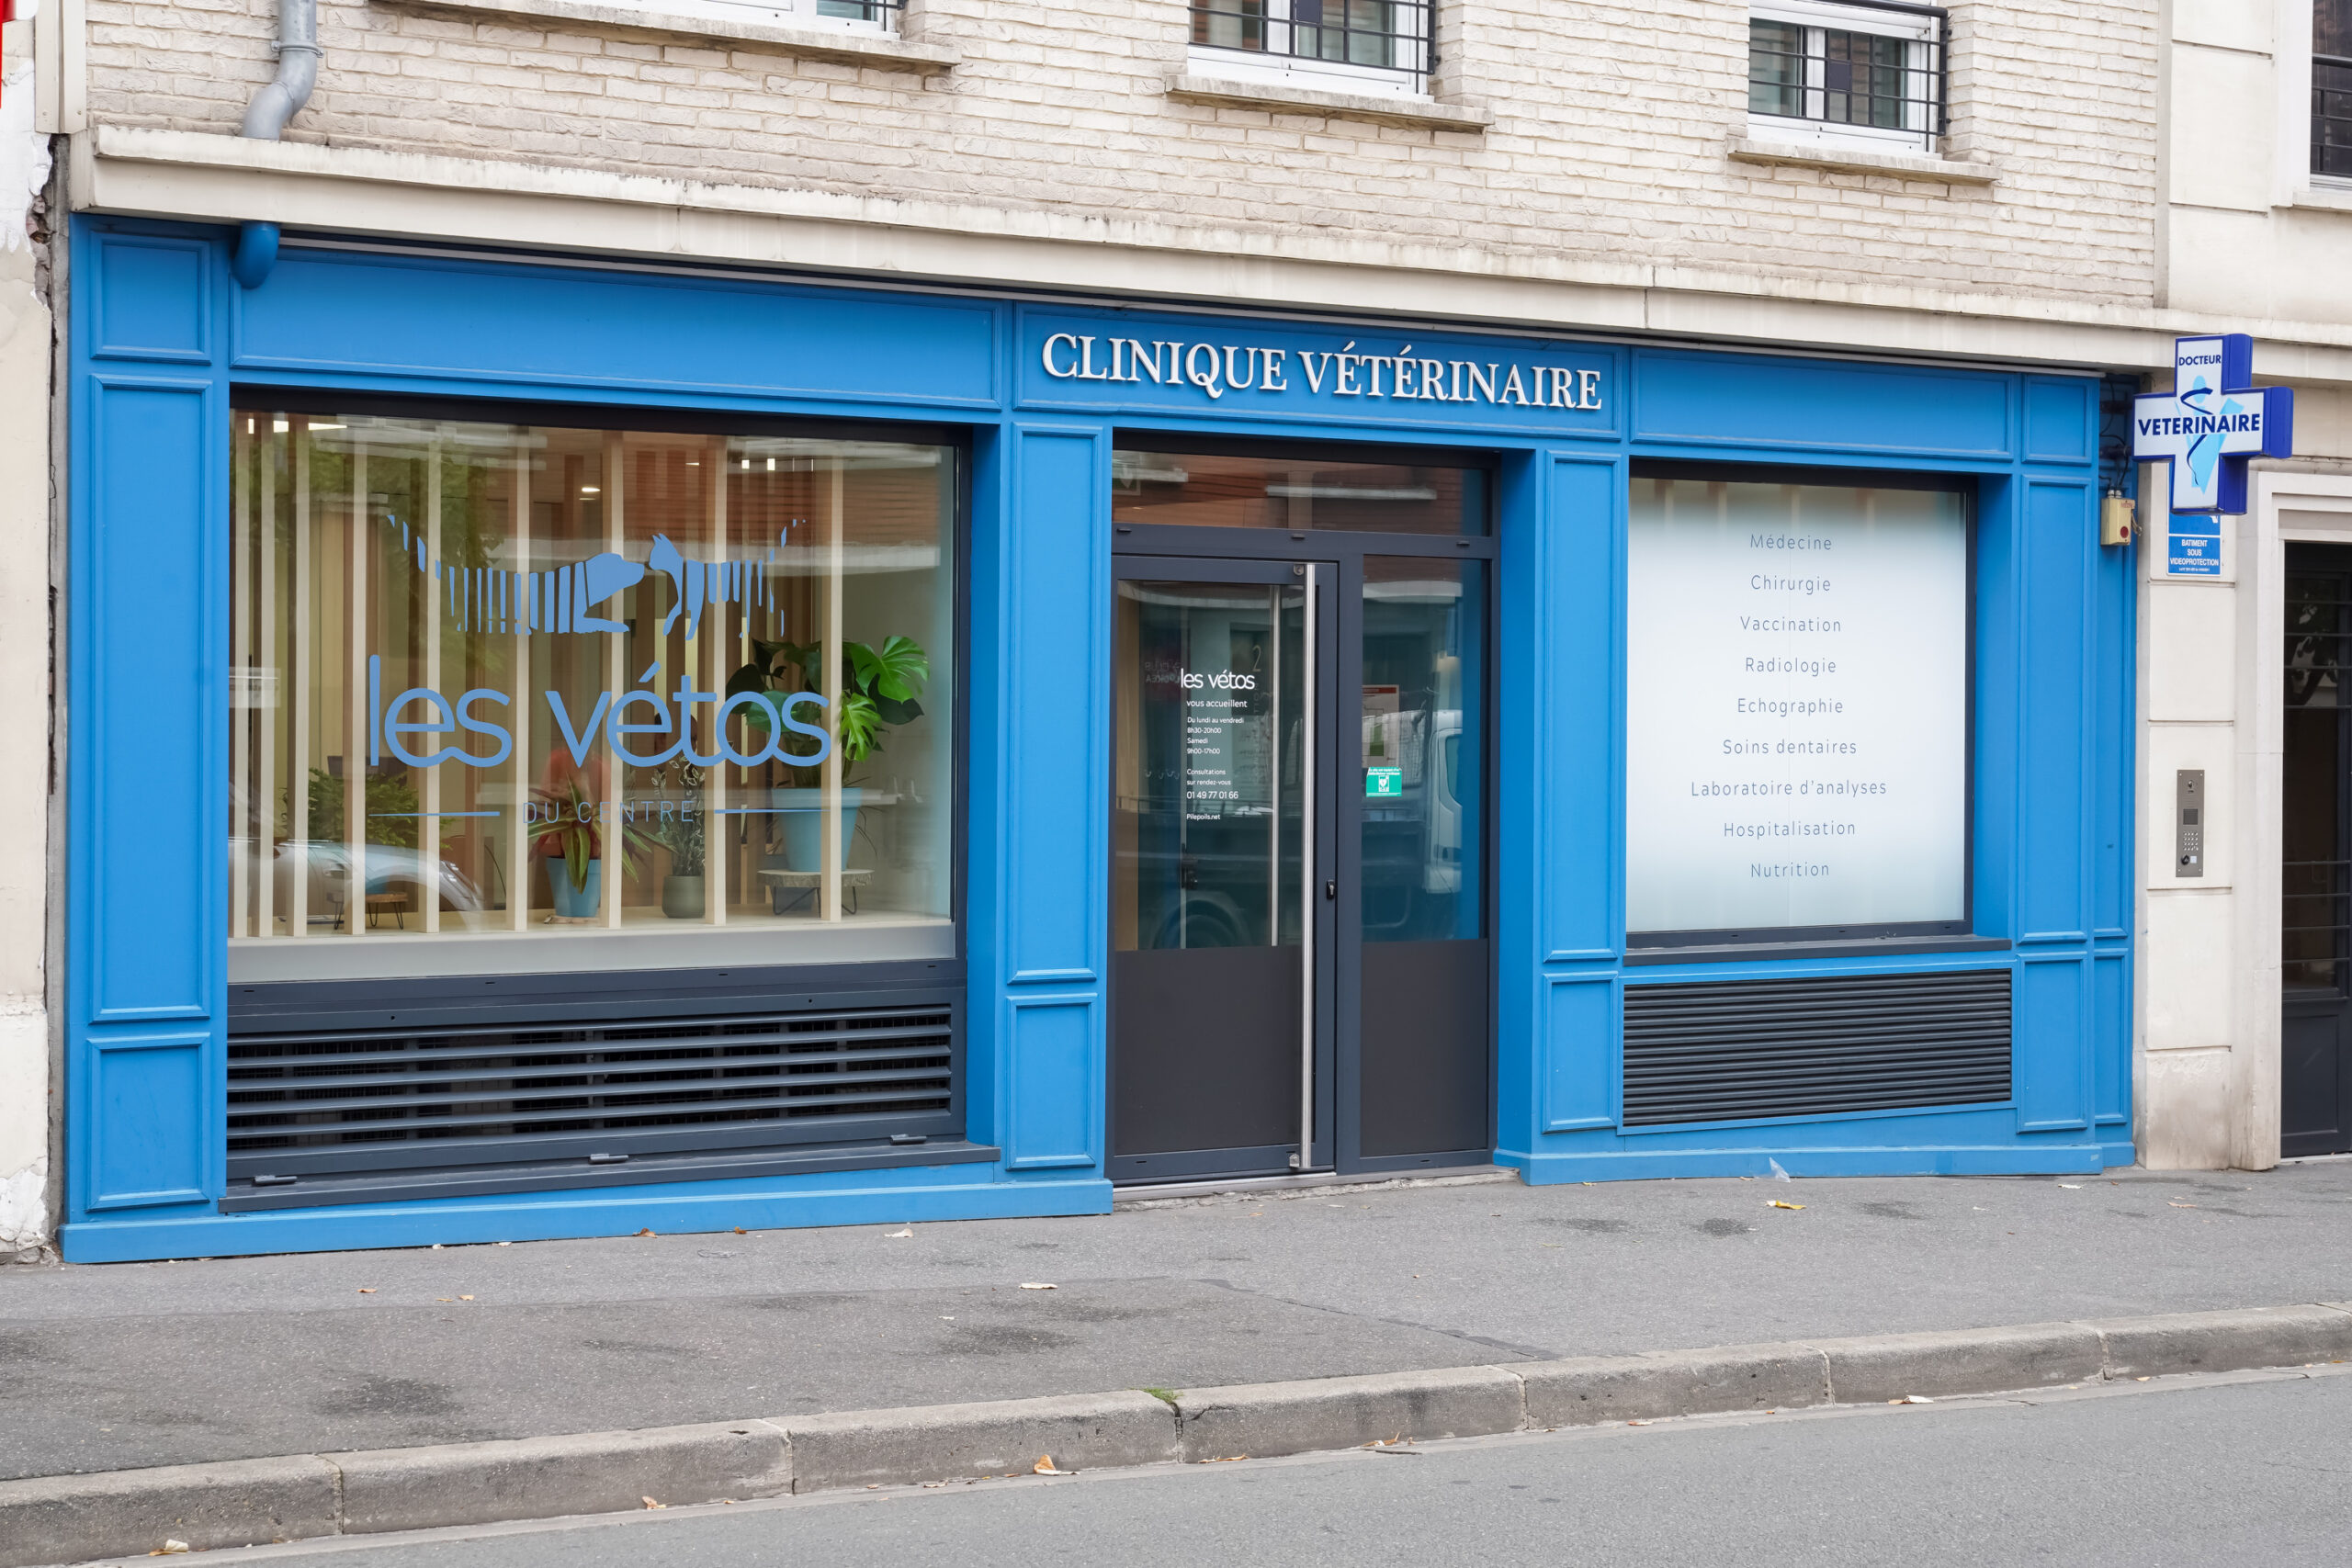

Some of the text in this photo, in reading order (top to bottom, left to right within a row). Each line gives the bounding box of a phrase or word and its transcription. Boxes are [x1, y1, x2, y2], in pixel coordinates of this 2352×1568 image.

[2178, 354, 2222, 367] DOCTEUR
[1041, 332, 1603, 411] CLINIQUE VÉTÉRINAIRE
[2138, 413, 2261, 436] VETERINAIRE
[1749, 533, 1833, 551] Médecine
[2181, 539, 2208, 547] BATIMENT
[2187, 548, 2202, 557] SOUS
[2169, 557, 2220, 567] VIDEOPROTECTION
[1750, 574, 1832, 595] Chirurgie
[1739, 615, 1842, 633] Vaccination
[1745, 657, 1838, 678] Radiologie
[1181, 668, 1204, 689] les
[1207, 669, 1255, 690] vétos
[368, 654, 832, 768] les vétos
[1205, 699, 1248, 708] accueillent
[1736, 697, 1844, 717] Echographie
[1723, 739, 1858, 755] Soins dentaires
[1186, 791, 1238, 799] 01 49 77 01 66
[1690, 779, 1888, 798] Laboratoire d'analyses
[522, 800, 695, 825] DU CENTRE
[1724, 819, 1856, 840] Hospitalisation
[1750, 861, 1830, 878] Nutrition
